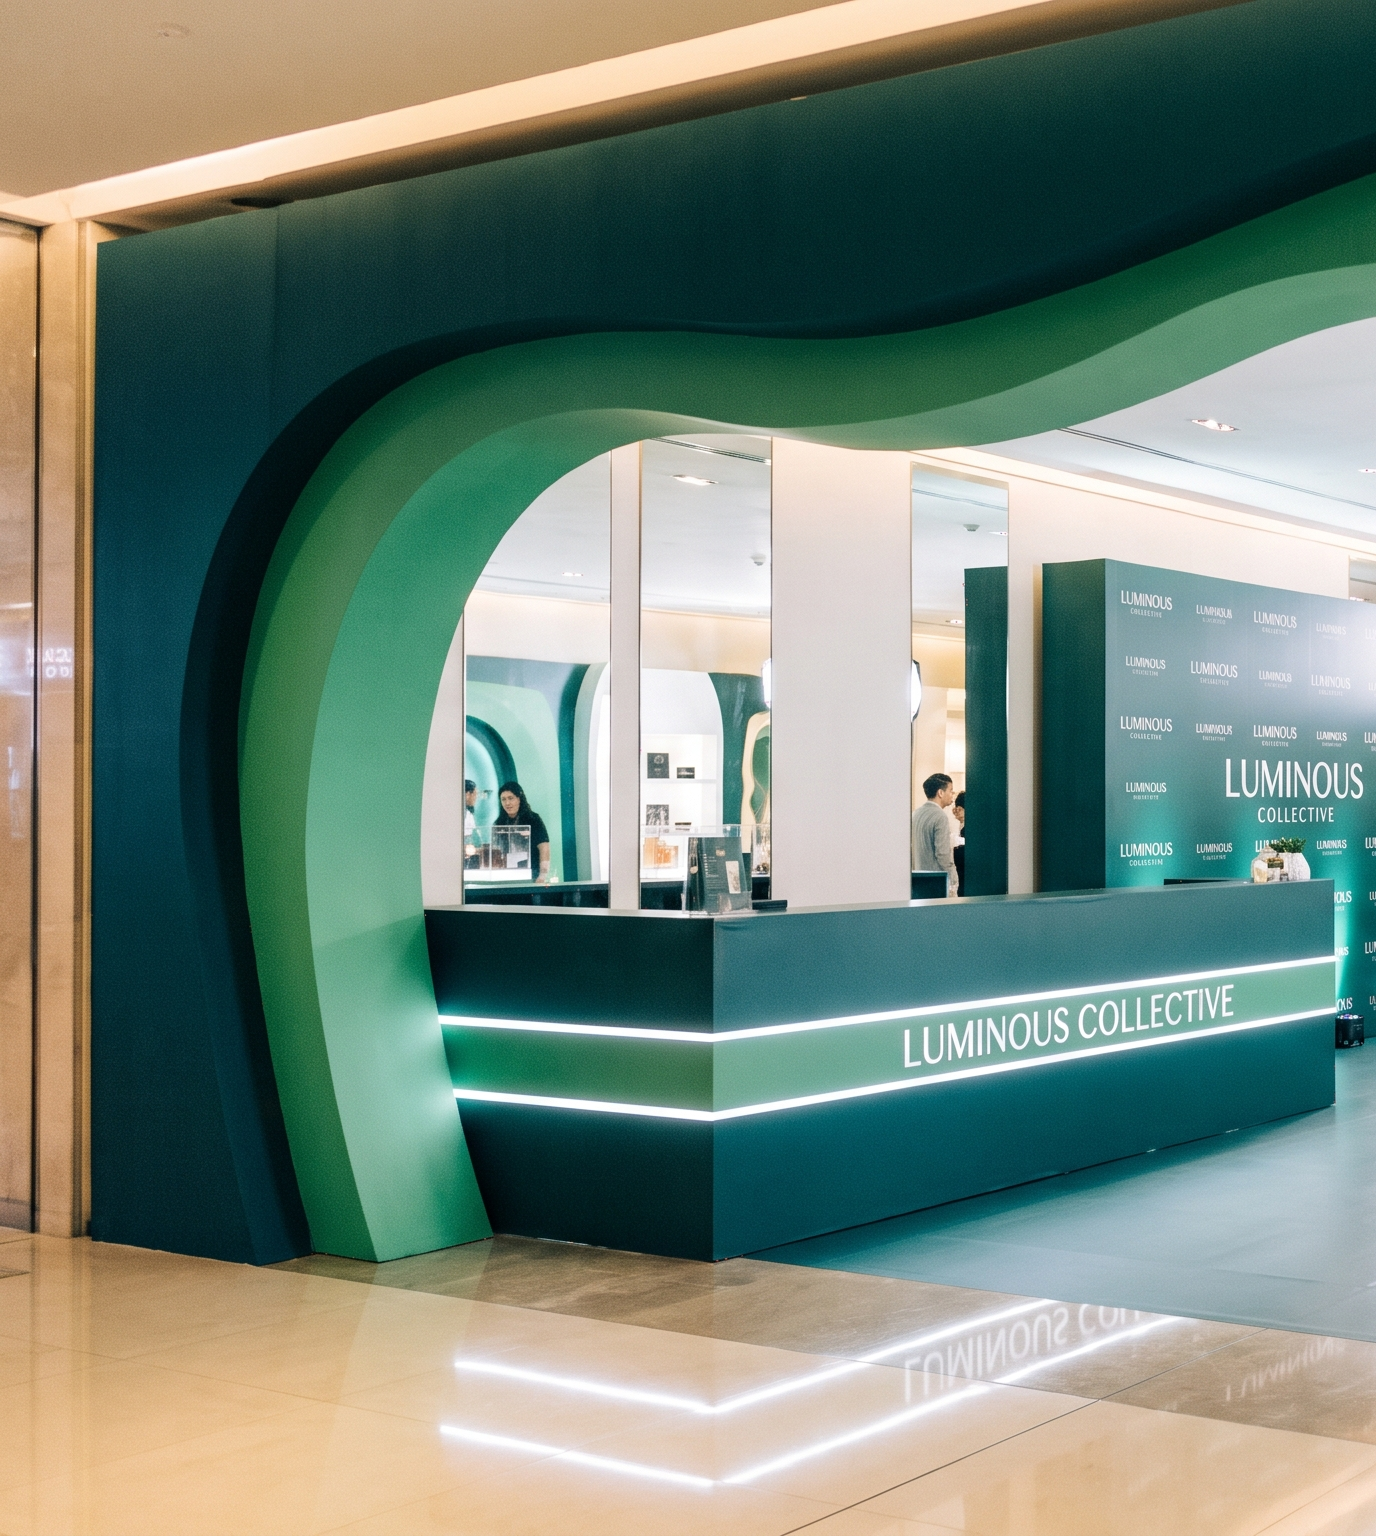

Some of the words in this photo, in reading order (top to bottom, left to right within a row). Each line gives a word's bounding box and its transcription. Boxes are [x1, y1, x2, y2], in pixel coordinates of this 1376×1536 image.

[1121, 590, 1173, 610] LUMINOUS
[1253, 611, 1297, 629] LUMINOUS
[1125, 656, 1166, 670] LUMINOUS
[1190, 661, 1238, 678] LUMINOUS
[1311, 674, 1351, 690] LUMINOUS
[1120, 716, 1173, 732] LUMINOUS
[1253, 725, 1297, 740] LUMINOUS
[1225, 758, 1364, 799] LUMINOUS
[1125, 782, 1167, 793] LUMINOUS
[1257, 807, 1335, 823] COLLECTIVE
[1120, 842, 1173, 858] LUMINOUS
[904, 1006, 1069, 1068] LUMINOUS
[1078, 984, 1234, 1040] COLLECTIVE
